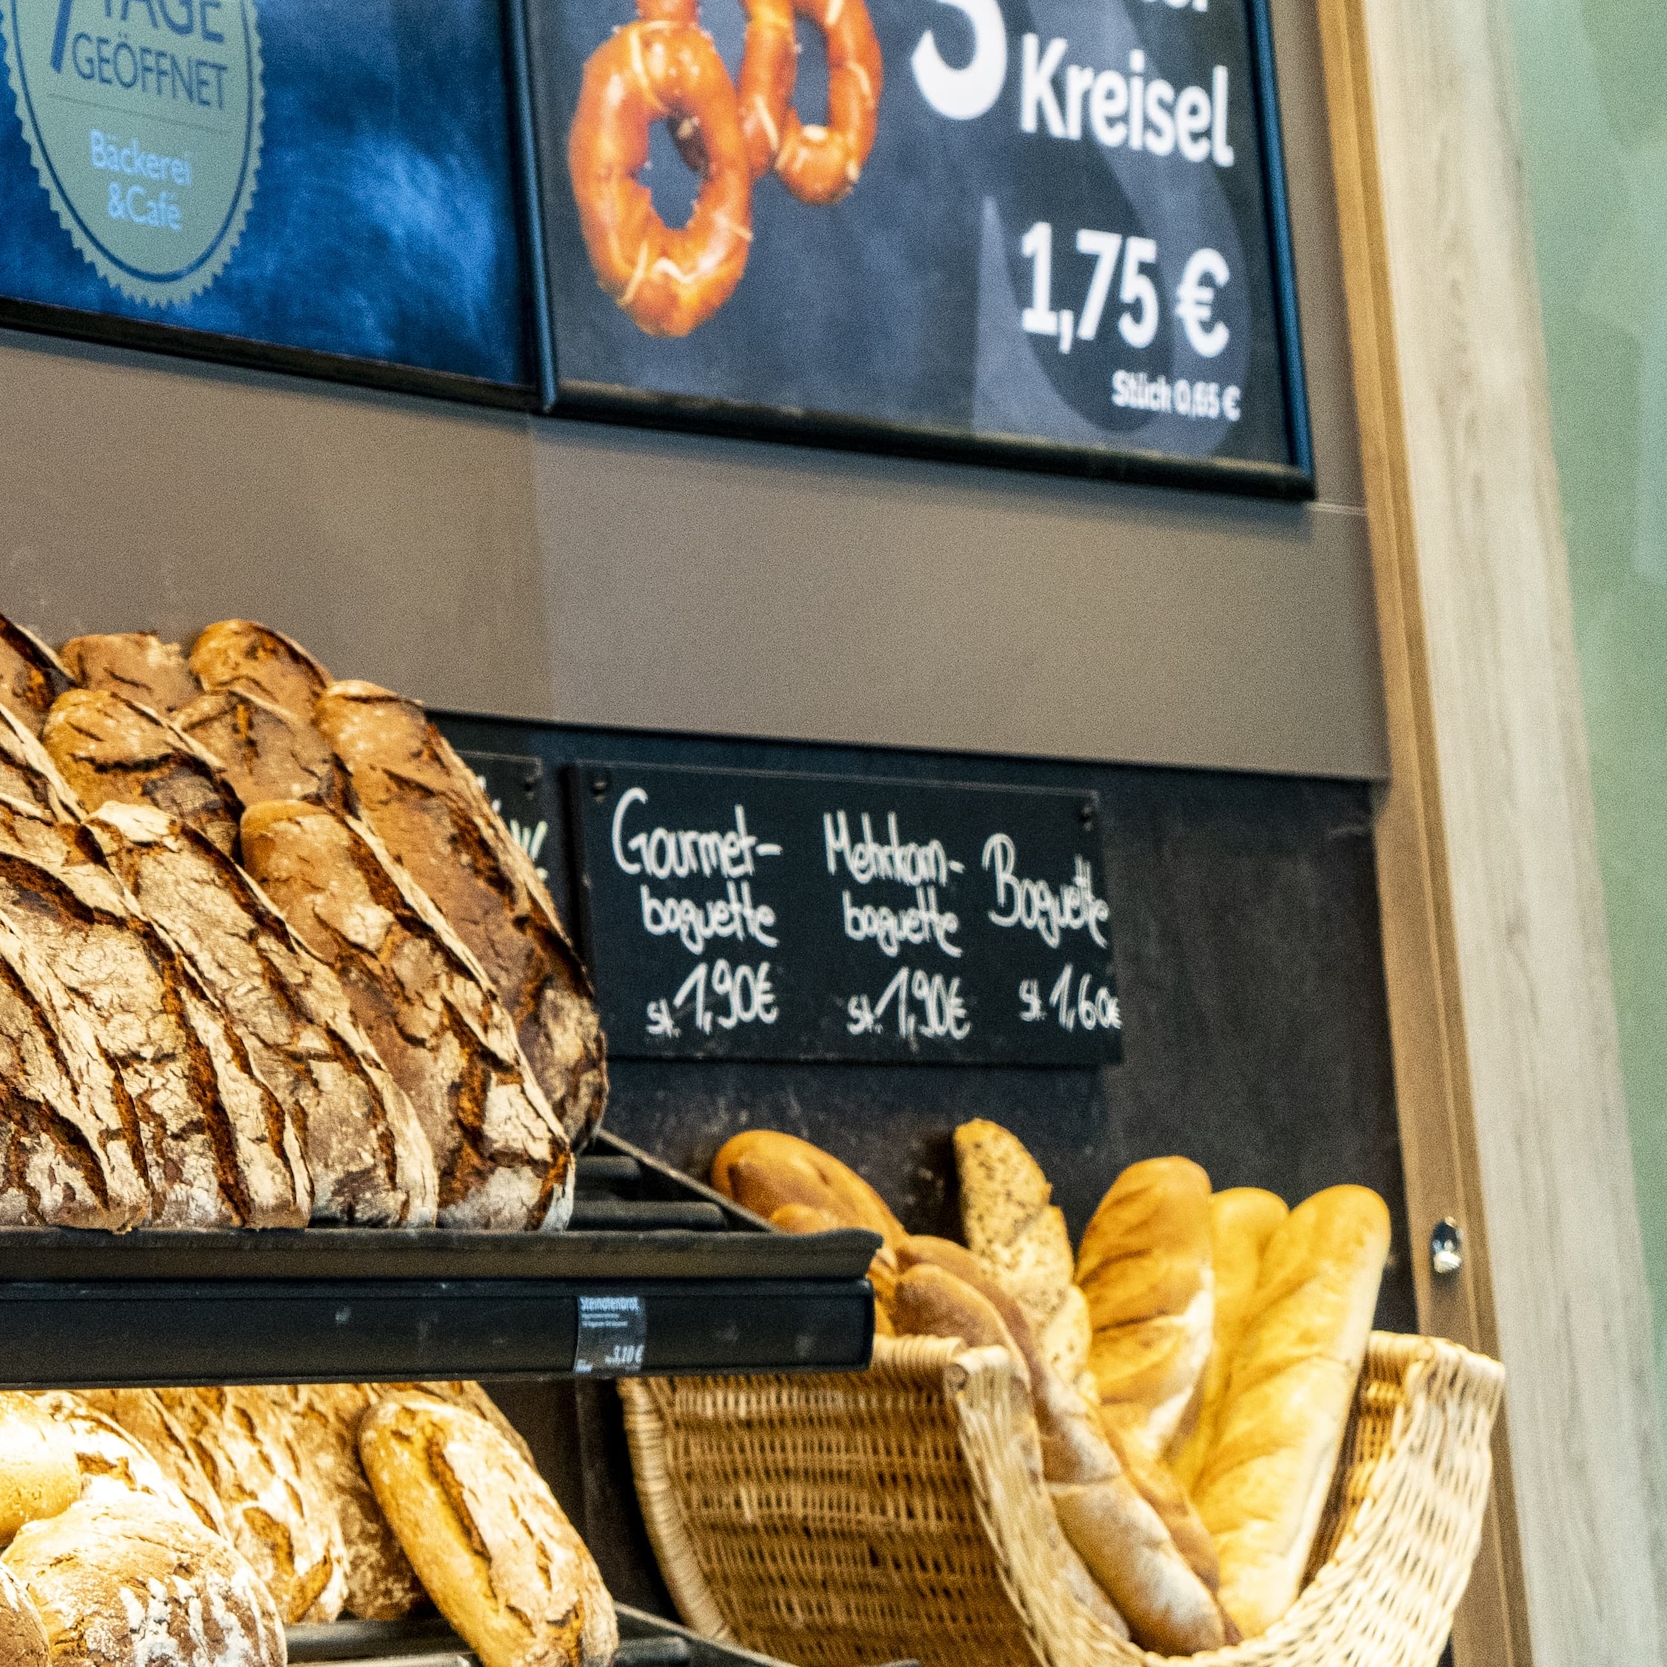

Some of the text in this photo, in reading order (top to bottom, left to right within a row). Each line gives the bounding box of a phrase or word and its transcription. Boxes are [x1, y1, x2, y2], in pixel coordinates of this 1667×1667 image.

[72, 30, 228, 110] GEÖFFNET
[1020, 33, 1235, 168] Kreisel
[90, 129, 193, 187] Bäckerei
[1021, 221, 1231, 359] 1,75 €
[1112, 369, 1173, 413] Stück
[1222, 384, 1242, 422] €
[612, 787, 783, 879] Gourmet-
[824, 809, 965, 887] Mehrkorn-
[640, 880, 779, 955] baguette
[842, 885, 963, 958] baguette
[982, 833, 1110, 949] Baguette
